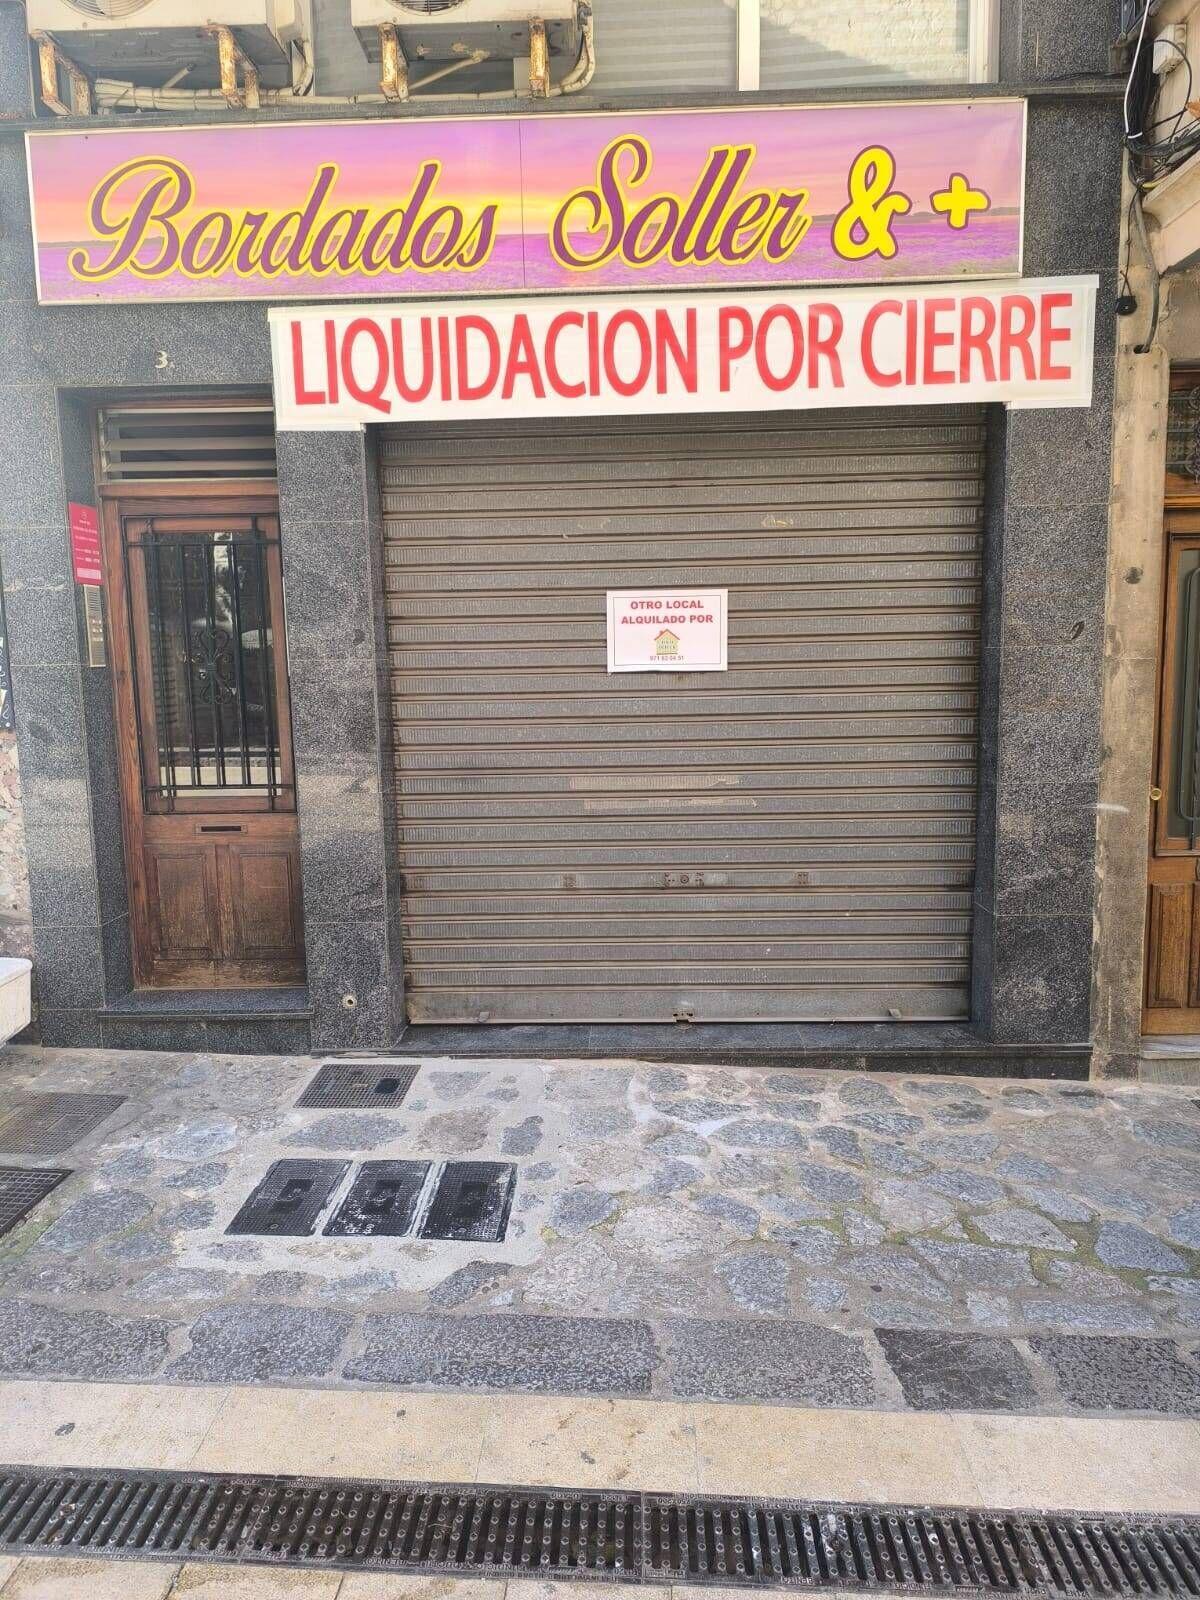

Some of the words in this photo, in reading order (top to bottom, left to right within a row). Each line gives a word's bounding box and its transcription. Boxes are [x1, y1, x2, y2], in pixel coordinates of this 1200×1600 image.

[67, 155, 499, 282] Bordados
[548, 134, 812, 272] Soller
[831, 145, 912, 260] &
[930, 172, 991, 230] +
[291, 309, 698, 414] LIQUIDACION
[718, 304, 844, 393] POR
[860, 293, 1073, 387] CIERRE
[621, 615, 686, 625] ALQUILADO
[689, 614, 713, 624] POR
[630, 600, 663, 610] OTRO
[666, 599, 704, 609] LOCAL
